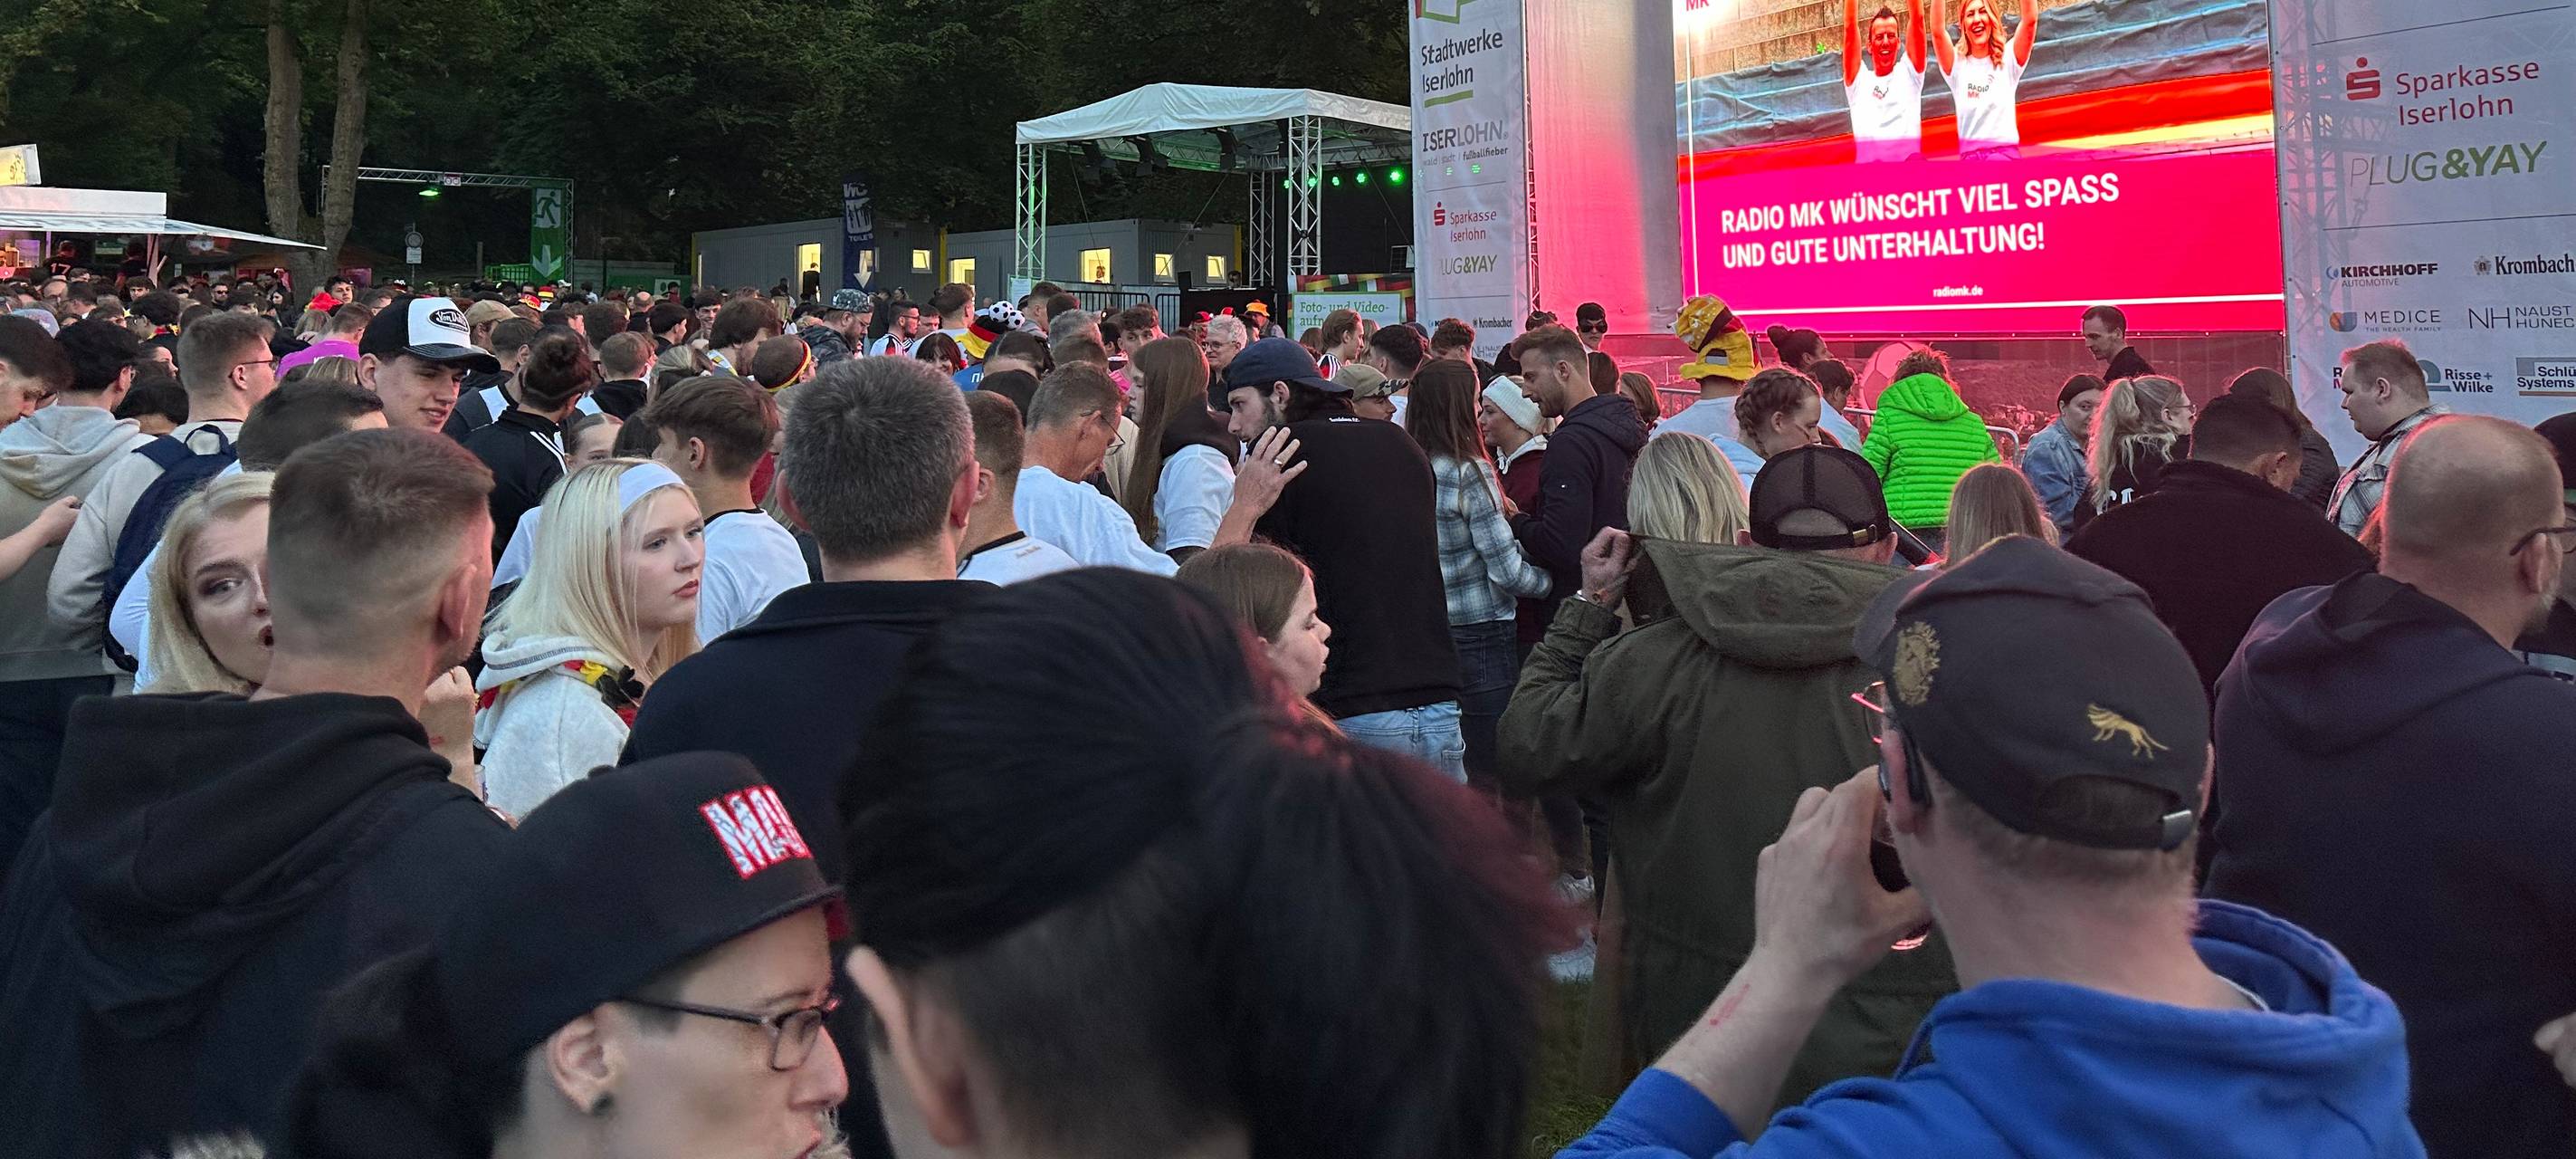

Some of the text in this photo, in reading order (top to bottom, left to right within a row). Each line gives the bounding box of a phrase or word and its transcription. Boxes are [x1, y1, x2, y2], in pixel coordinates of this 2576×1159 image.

[1421, 28, 1503, 66] Stadtwerke
[1422, 64, 1474, 94] Iserlohn
[2396, 61, 2540, 99] Sparkasse
[2399, 94, 2514, 127] Iserlohn
[1463, 146, 1509, 161] fußballfieber
[2350, 140, 2548, 187] PLUG&YAY
[1722, 172, 2120, 234] RADIO MK WÜNSCHT VIEL SPASS
[1450, 210, 1497, 227] Sparkasse
[1450, 228, 1486, 243] Iserlohn
[1722, 222, 2046, 269] UND GUTE UNTERHALTUNG!
[50, 263, 72, 275] 17
[1439, 254, 1498, 275] LUG&YAY
[2341, 263, 2438, 278] KIRCHHOFF
[2495, 253, 2576, 275] Krombach
[2342, 277, 2400, 288] AUTOMOTIVE
[1932, 285, 1984, 297] radiomk.de
[1300, 302, 1327, 313] Foto-
[1353, 302, 1390, 313] Video-
[1478, 316, 1513, 329] Krombacher
[2364, 310, 2441, 324] MEDICE
[2468, 305, 2571, 330] NH NAUST
[2515, 317, 2576, 329] HUNEC
[2445, 369, 2482, 381] Risse
[2537, 366, 2576, 378] Schlü
[2451, 381, 2494, 393] Wilke
[2516, 377, 2575, 390] Systems
